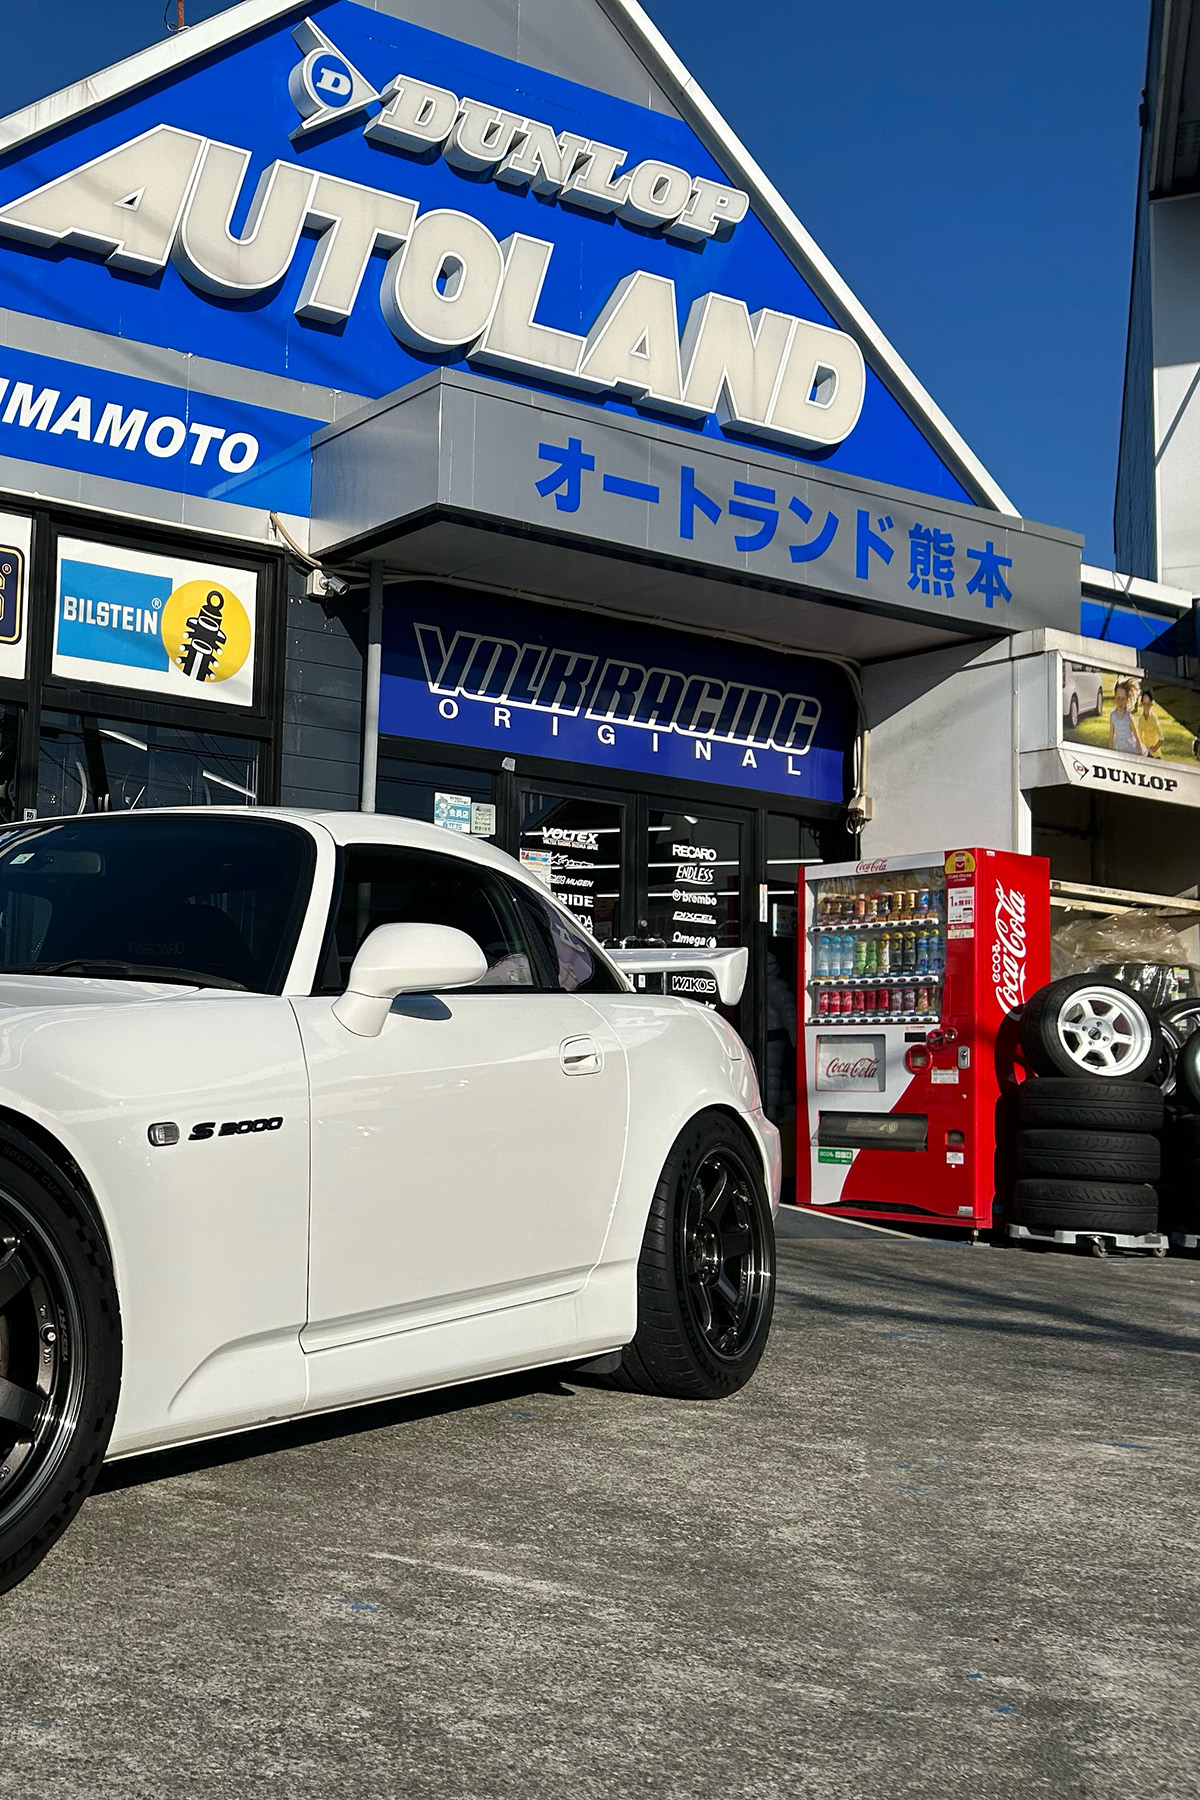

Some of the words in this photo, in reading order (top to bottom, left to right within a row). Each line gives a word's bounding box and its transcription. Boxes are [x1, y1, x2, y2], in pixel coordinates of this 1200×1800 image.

[368, 74, 750, 241] DUNLOP
[534, 436, 1013, 609] オートランド熊本
[63, 595, 160, 637] BILSTEIN
[413, 622, 599, 717] VOLK
[585, 658, 822, 755] RACING
[438, 698, 802, 776] ORIGINAL
[1092, 764, 1178, 792] DUNLOP
[542, 826, 599, 844] VOLTEX
[672, 844, 717, 861] RECARO
[565, 878, 594, 888] MUGEN
[675, 865, 715, 882] ENDLESS
[552, 892, 594, 908] RIDE
[682, 891, 717, 906] brembo
[672, 911, 717, 925] DIXCEL
[1, 1146, 40, 1175] SPORT
[40, 1174, 63, 1196] CUP
